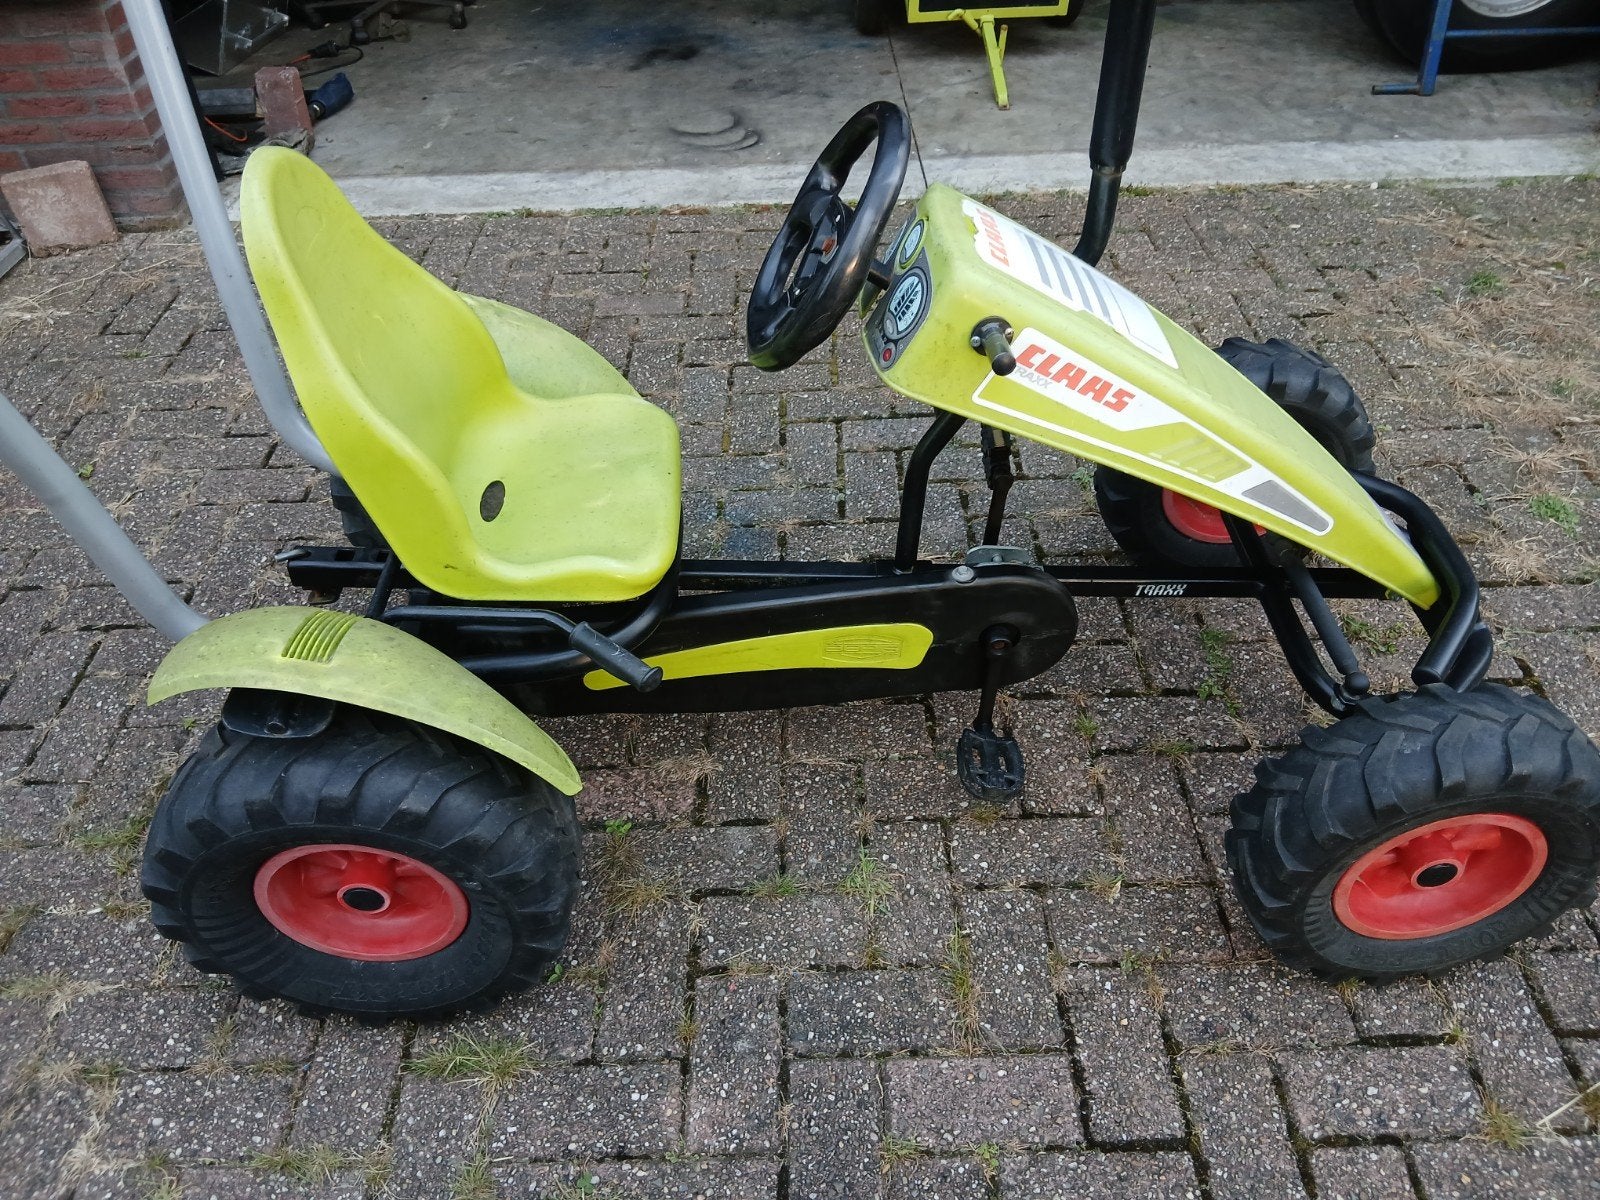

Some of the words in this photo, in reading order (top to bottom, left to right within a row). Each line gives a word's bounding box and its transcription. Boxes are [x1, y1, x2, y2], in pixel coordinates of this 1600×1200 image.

[976, 208, 1010, 267] CLAAS
[1015, 366, 1053, 389] RAXX
[1016, 344, 1136, 413] CLAAS
[1135, 584, 1188, 596] TRAXX
